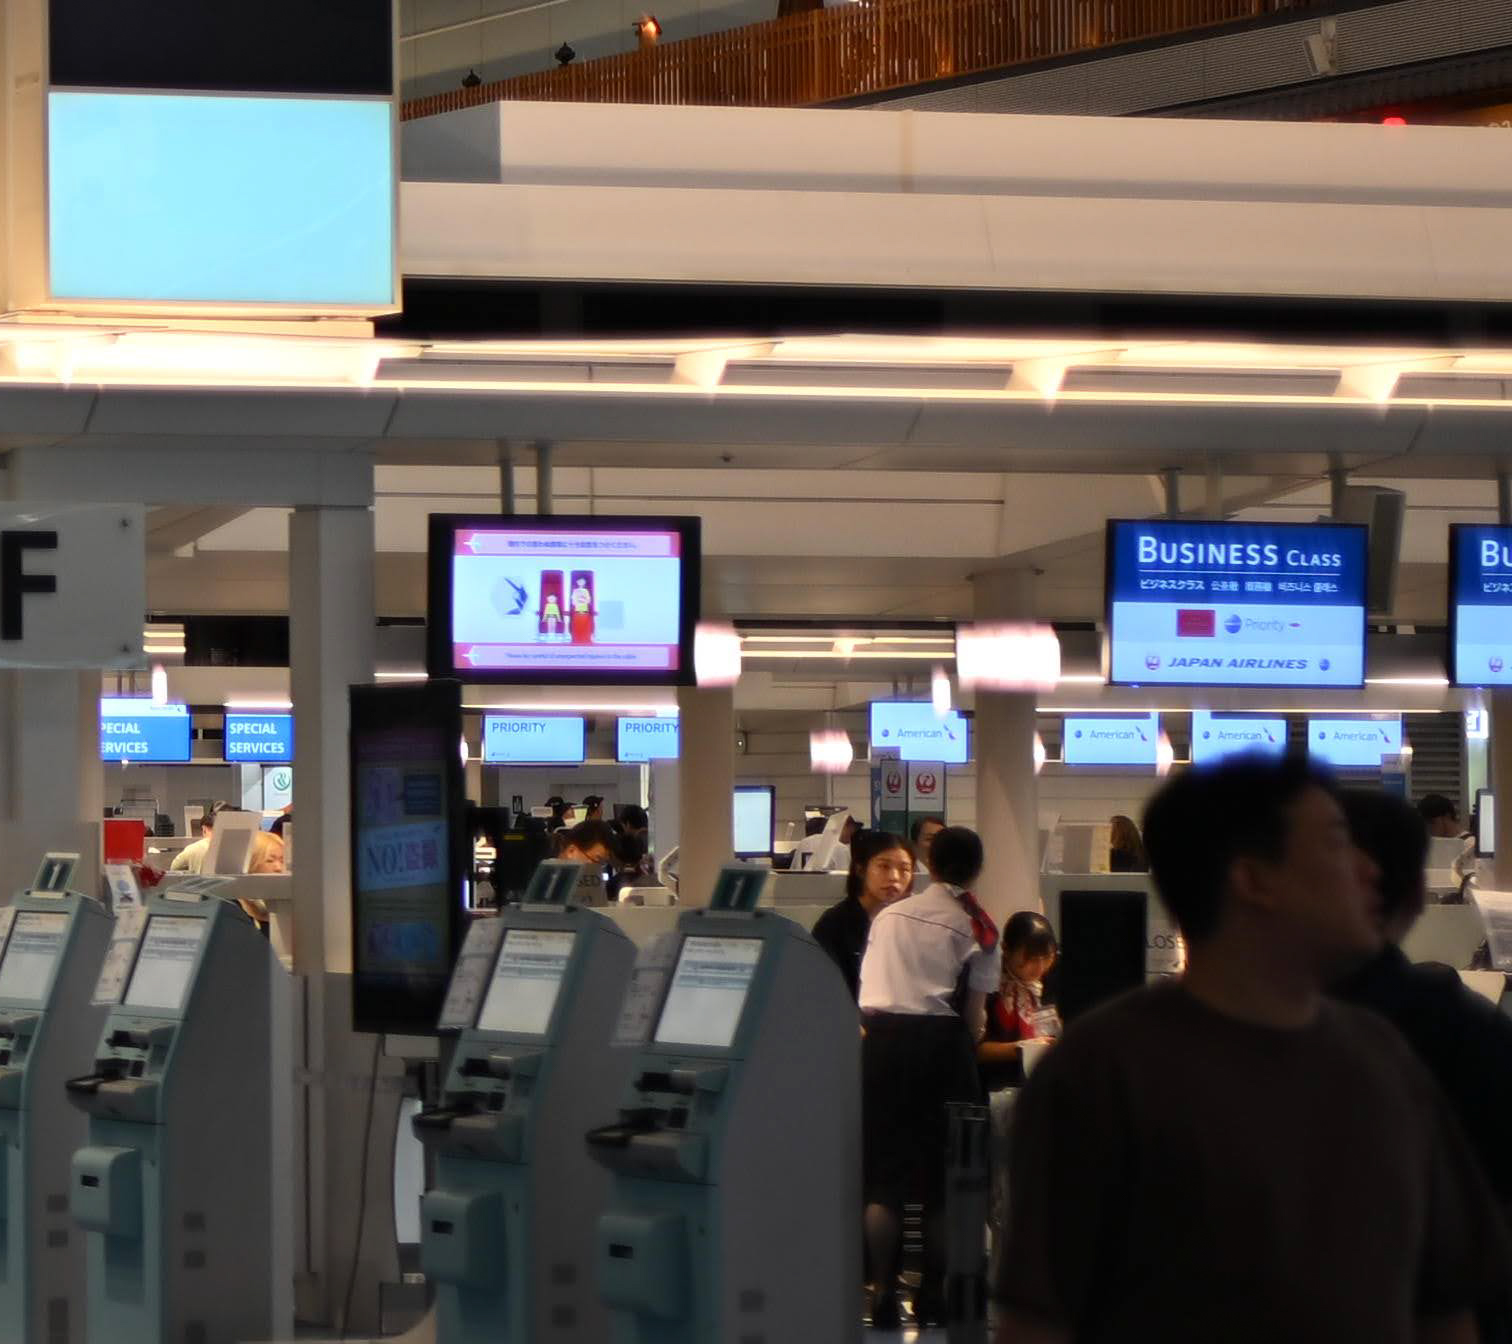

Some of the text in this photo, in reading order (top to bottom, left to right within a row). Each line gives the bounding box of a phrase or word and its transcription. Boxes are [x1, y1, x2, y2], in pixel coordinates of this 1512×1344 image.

[1137, 535, 1343, 568] BUSINESS CLASS
[0, 531, 59, 641] F
[1139, 578, 1205, 591] ビジネスクラス
[1244, 617, 1286, 633] Priority
[1167, 656, 1309, 670] JAPAN AIRLINES
[491, 722, 547, 733] PRIORITY
[624, 722, 679, 733] PRIORITY
[896, 727, 943, 739] American
[1089, 728, 1135, 740] American
[1217, 729, 1262, 742] American
[1333, 730, 1378, 742] American
